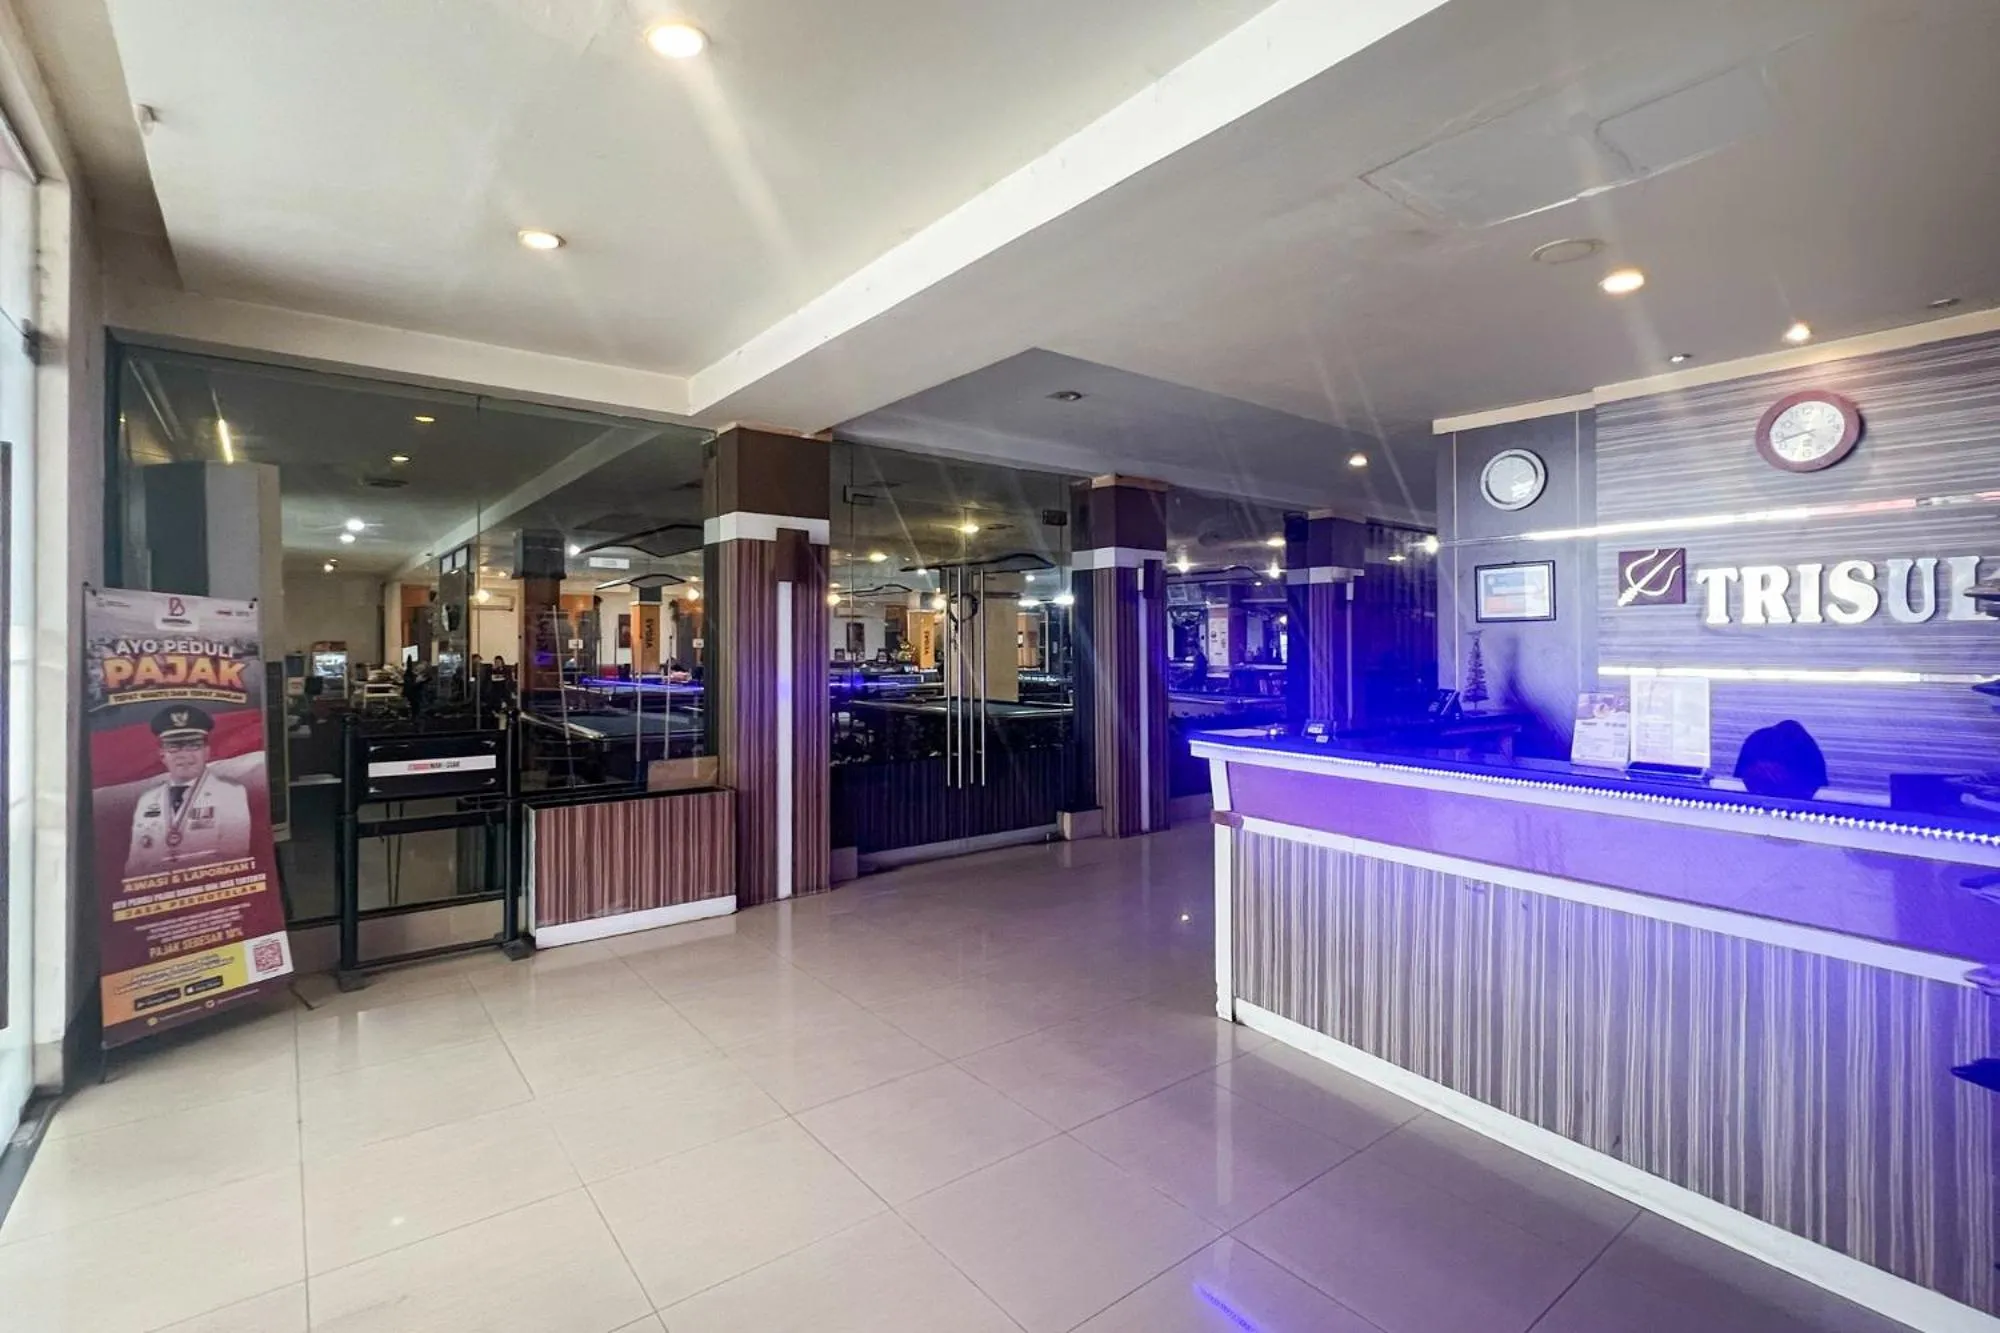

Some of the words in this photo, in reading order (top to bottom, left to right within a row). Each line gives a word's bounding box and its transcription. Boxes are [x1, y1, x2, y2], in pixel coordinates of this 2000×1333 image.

[116, 639, 157, 655] AYO
[163, 640, 234, 658] PEDULI
[103, 656, 246, 689] PAJAK
[123, 878, 169, 893] AWASI
[184, 863, 249, 883] LAPORKAN
